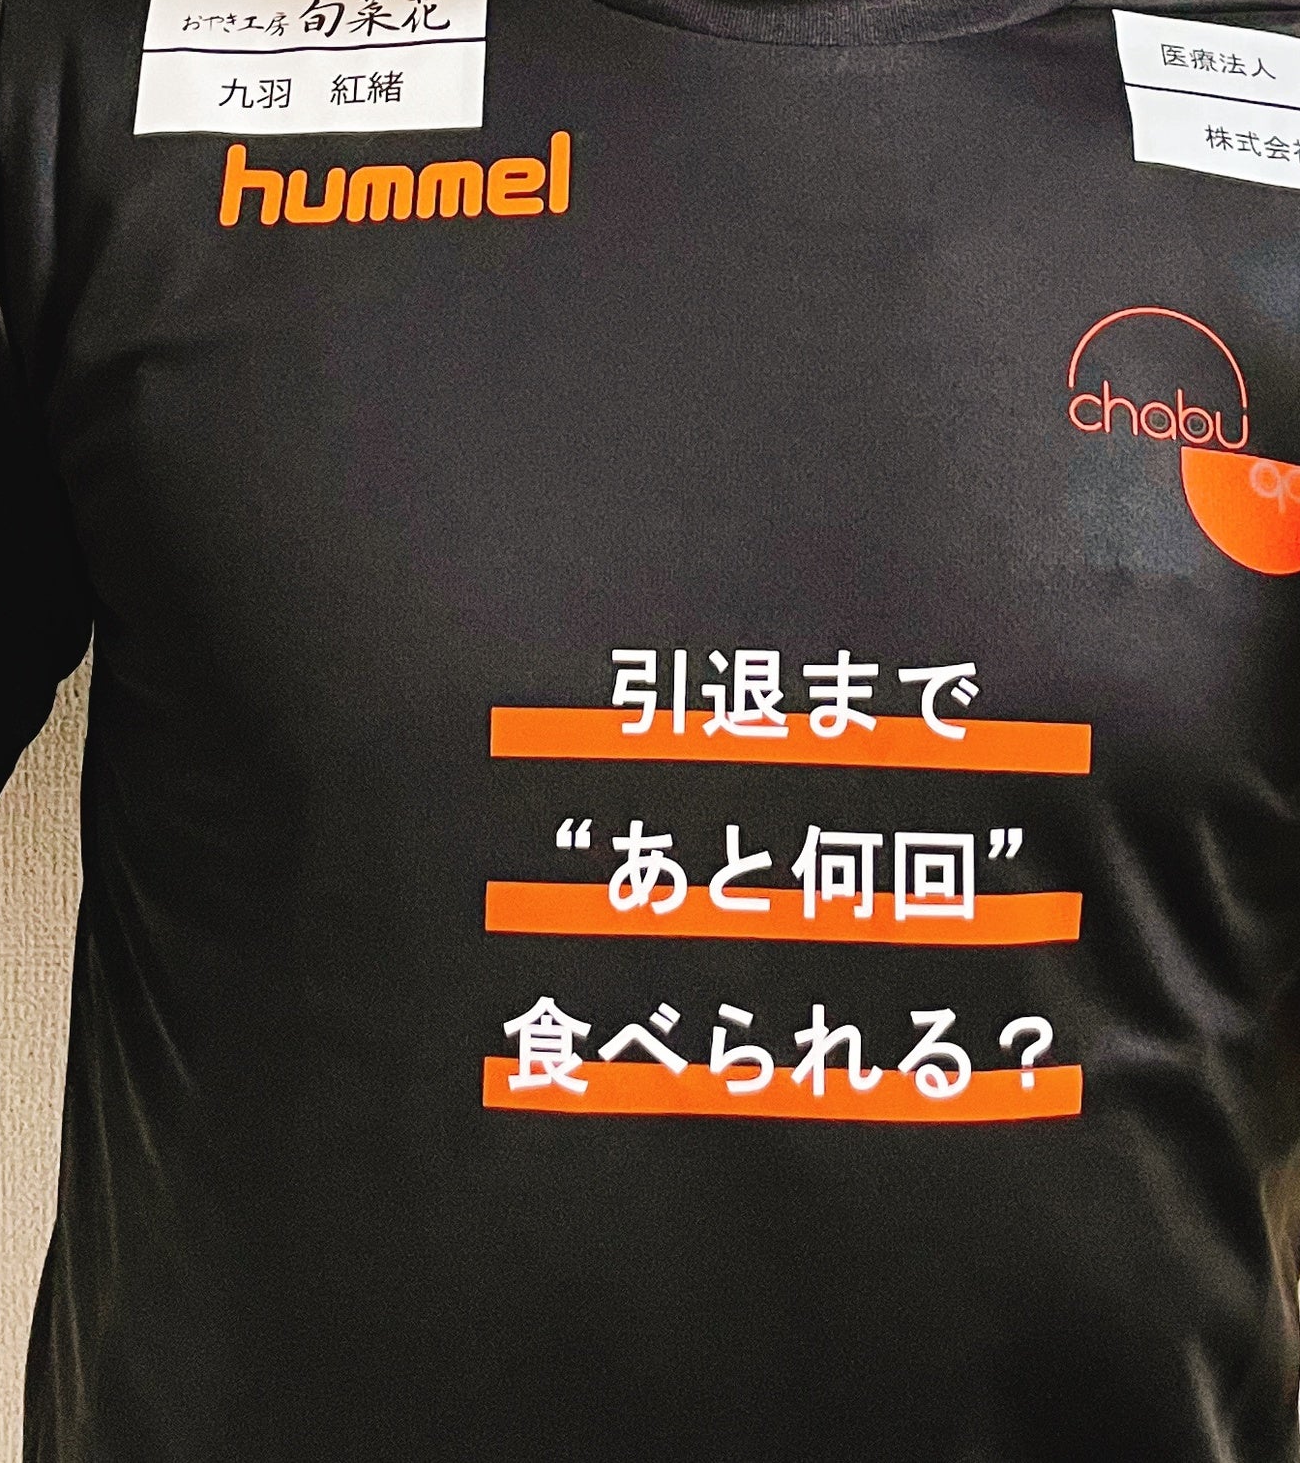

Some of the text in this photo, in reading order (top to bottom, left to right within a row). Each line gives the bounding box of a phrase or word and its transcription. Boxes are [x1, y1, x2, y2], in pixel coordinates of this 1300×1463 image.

[183, 13, 290, 37] おやき工房
[218, 70, 404, 109] 九羽 紅緒
[1161, 43, 1277, 81] 医療法人
[218, 130, 572, 228] hummel
[1068, 379, 1250, 451] chabu
[610, 648, 981, 741] 引退まで
[502, 996, 1055, 1100] 食べられる？
